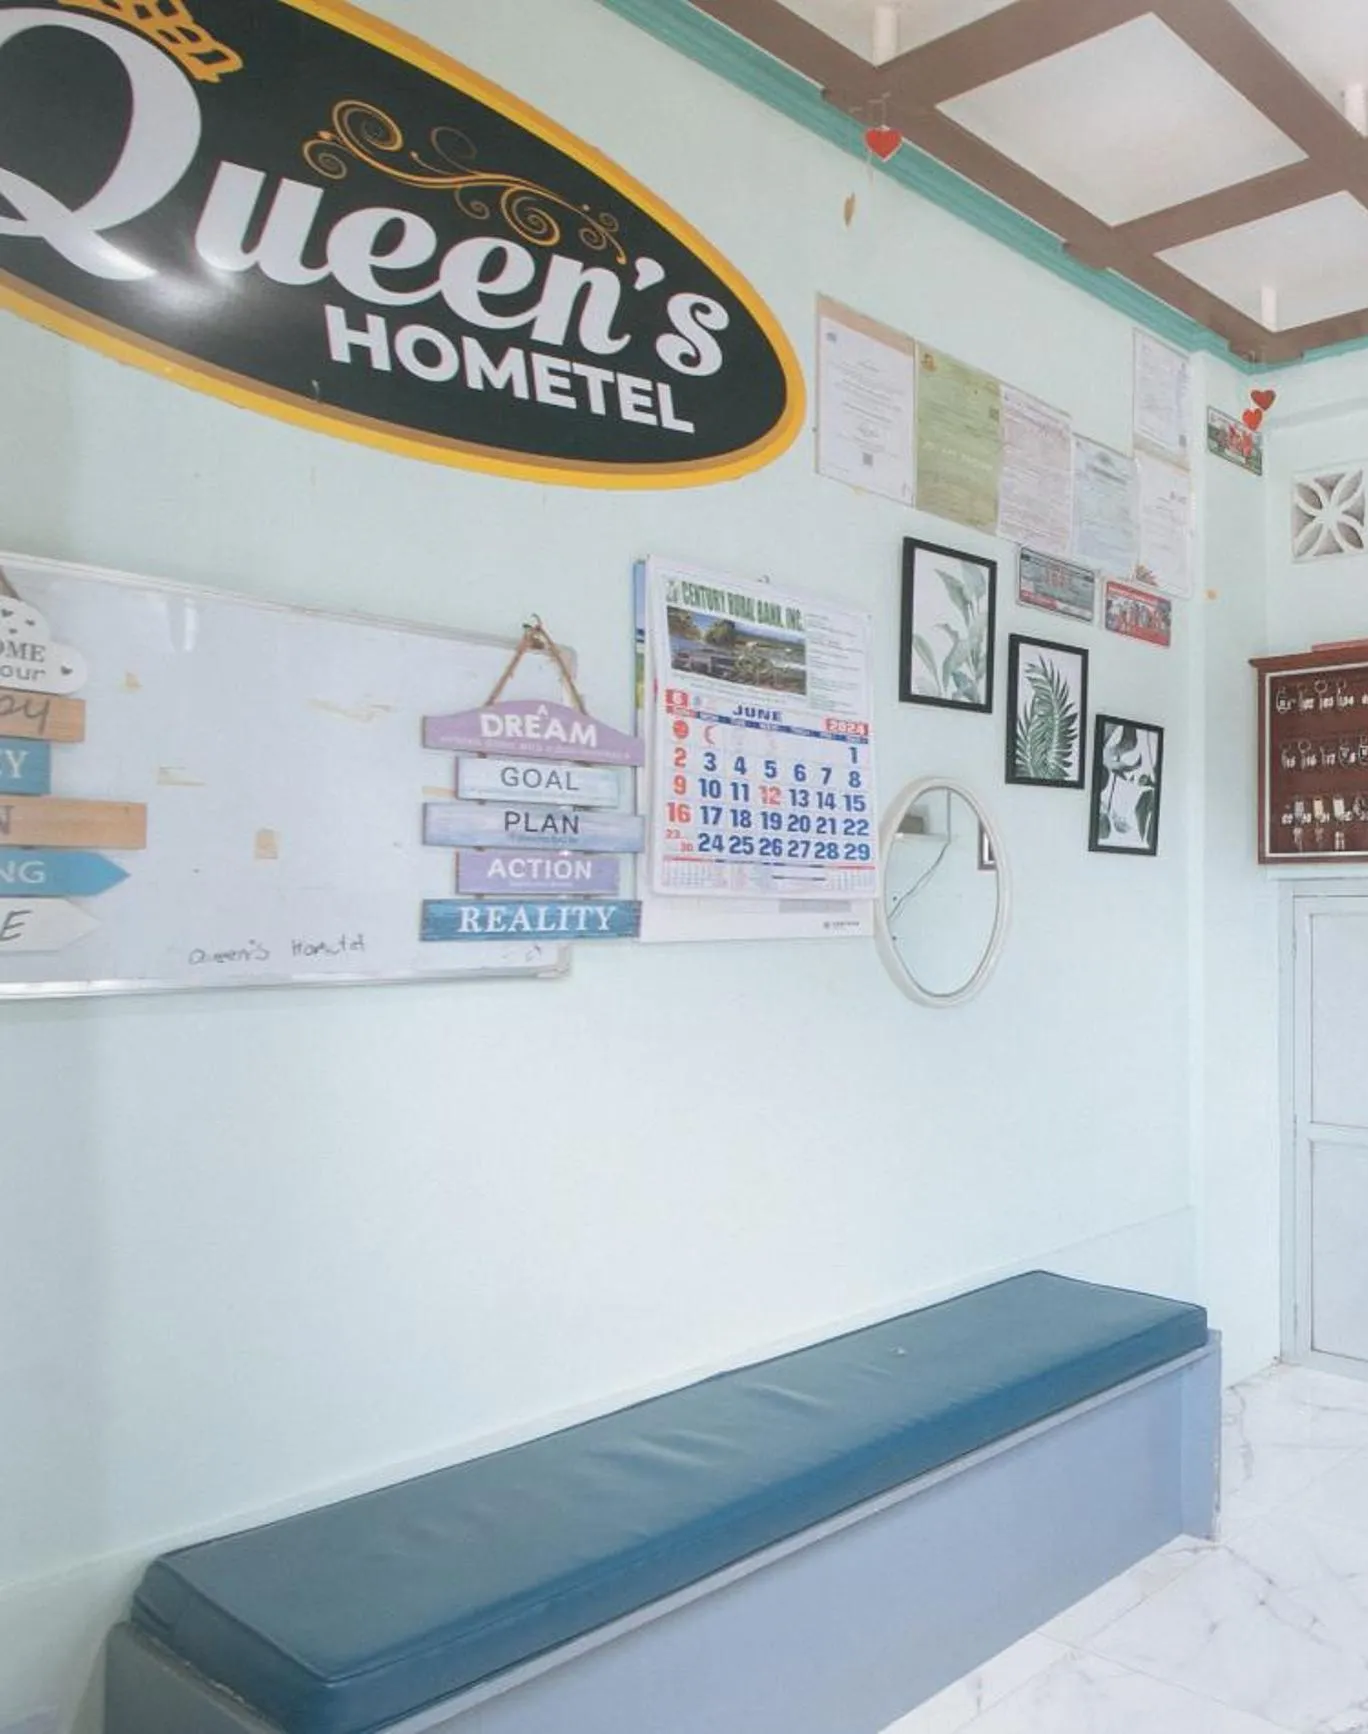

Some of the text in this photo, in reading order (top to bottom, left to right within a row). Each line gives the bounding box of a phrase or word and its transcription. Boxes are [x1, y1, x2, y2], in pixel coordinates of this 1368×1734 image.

[0, 8, 730, 376] Queen's
[323, 304, 696, 435] HOMETEL
[681, 580, 724, 613] CENTURY
[537, 704, 549, 717] A
[733, 704, 783, 722] JUNE
[480, 712, 599, 748] DREAM
[828, 719, 867, 736] 2024
[674, 746, 862, 788] 2 3 4 5 6 7 8
[848, 746, 858, 764] 1
[500, 766, 580, 791] GOAL
[674, 774, 867, 813] 9 10 11 12 13 14 15
[504, 810, 580, 835] PLAN
[667, 801, 870, 837] 16 17 18 19 20 21 22
[698, 832, 725, 853] 24
[728, 834, 754, 856] 25
[759, 837, 783, 857] 26
[787, 839, 811, 859] 27
[814, 841, 840, 860] 28
[843, 842, 871, 862] 29
[487, 857, 592, 880] ACTION
[457, 905, 617, 934] REALITY
